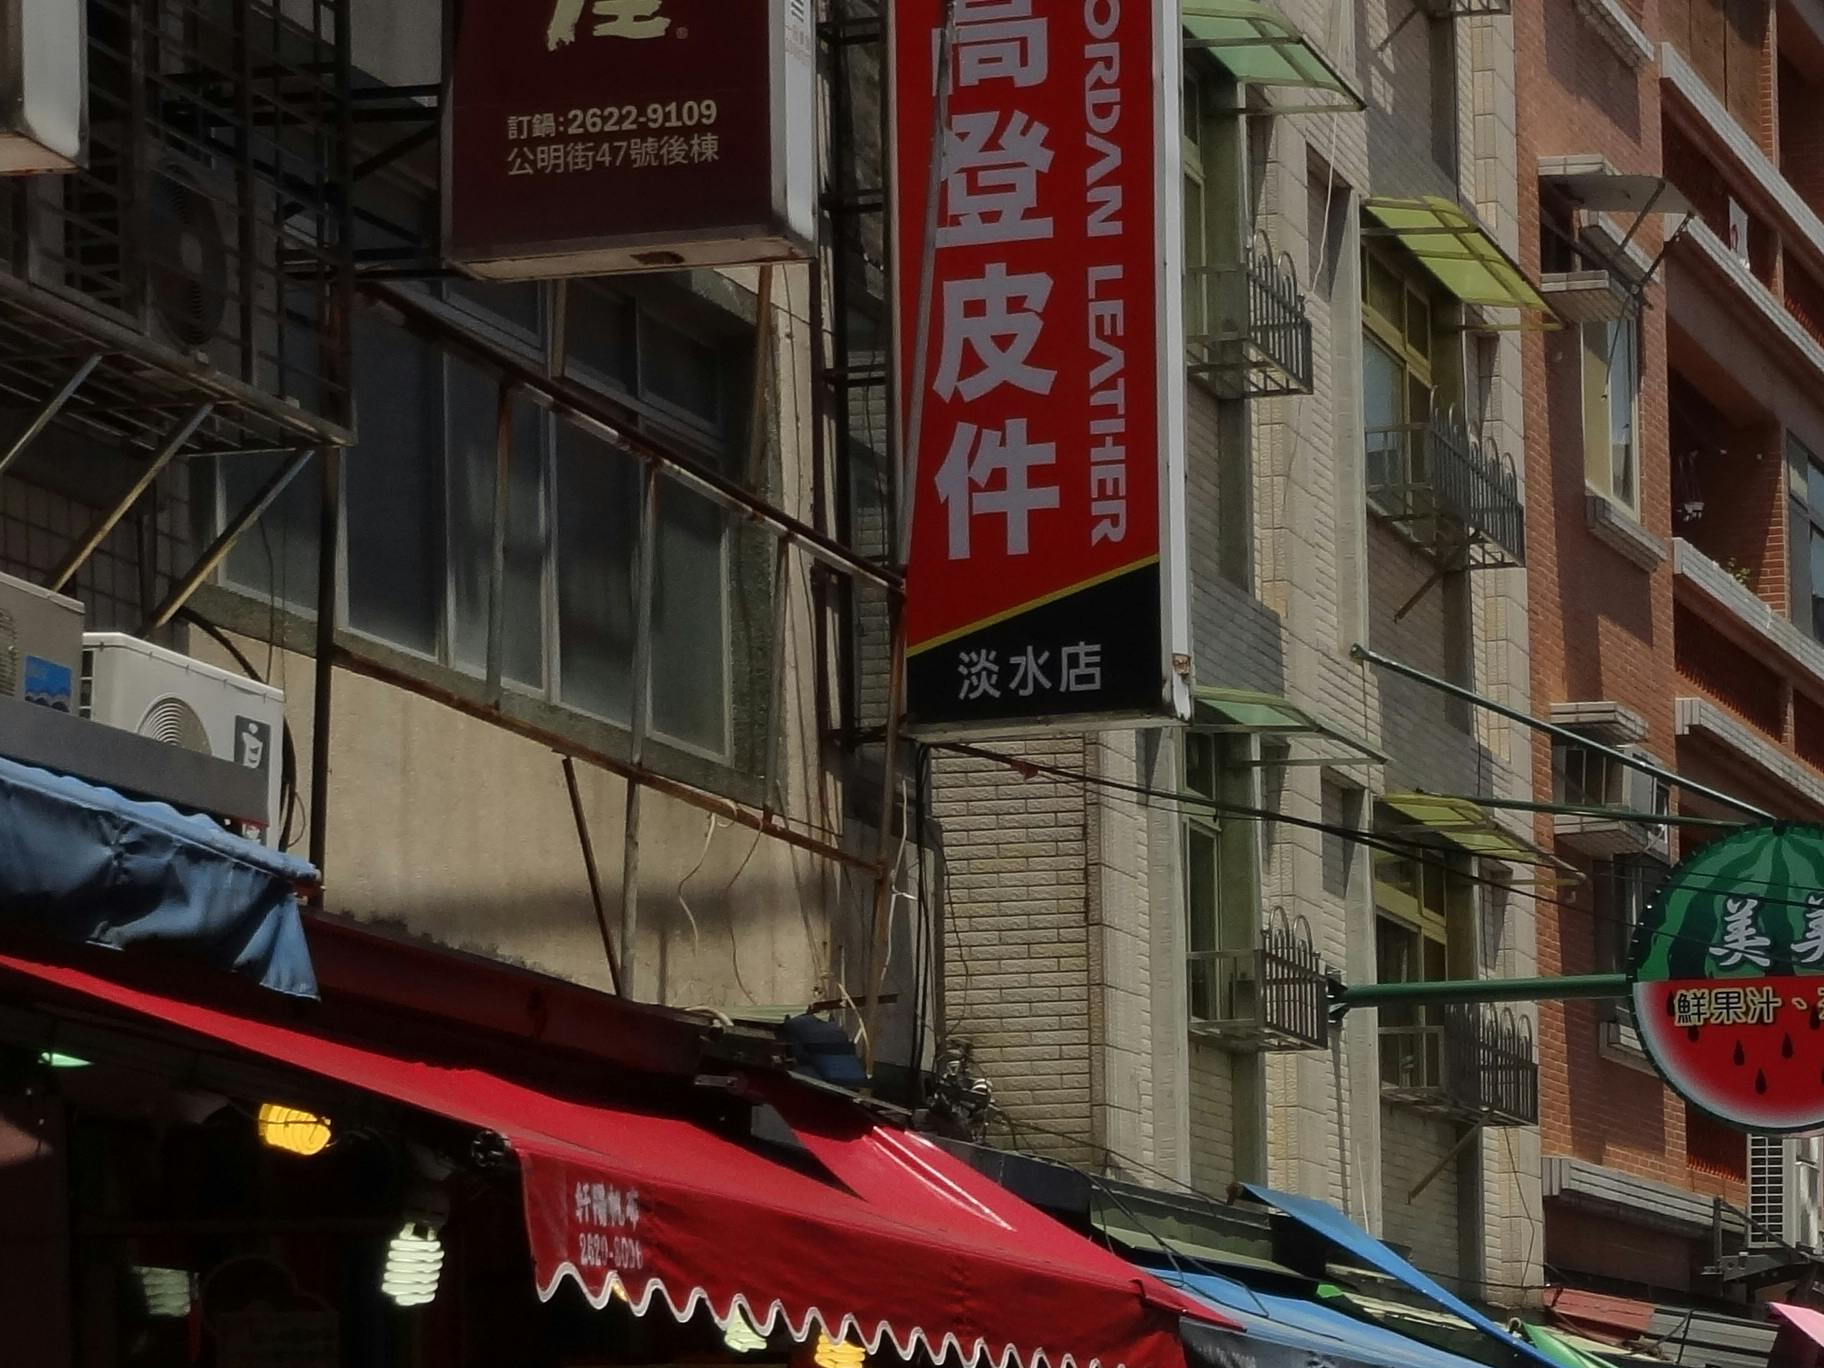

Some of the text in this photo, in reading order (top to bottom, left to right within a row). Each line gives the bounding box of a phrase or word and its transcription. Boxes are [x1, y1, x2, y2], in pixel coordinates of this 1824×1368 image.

[507, 132, 720, 176] 公明街47號後棟
[932, 0, 1060, 560] 高登皮件
[1087, 264, 1127, 547] LEATHER
[957, 641, 1102, 700] 淡水店
